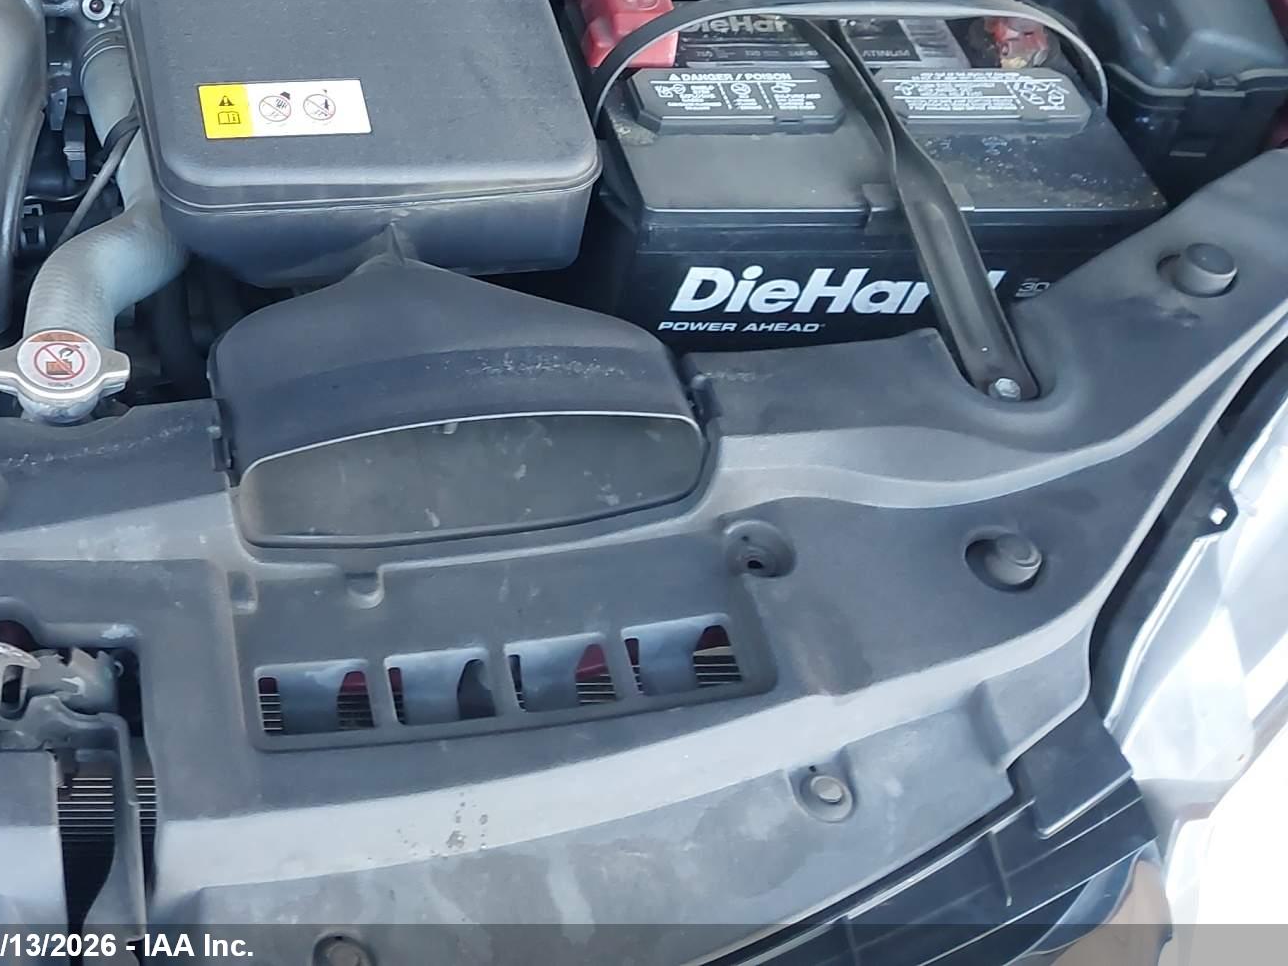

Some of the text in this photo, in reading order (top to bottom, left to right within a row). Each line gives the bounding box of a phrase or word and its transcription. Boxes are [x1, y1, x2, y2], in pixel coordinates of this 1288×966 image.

[680, 73, 734, 81] DANGER
[743, 73, 792, 81] POISON
[657, 321, 820, 333] POWER AHEAD
